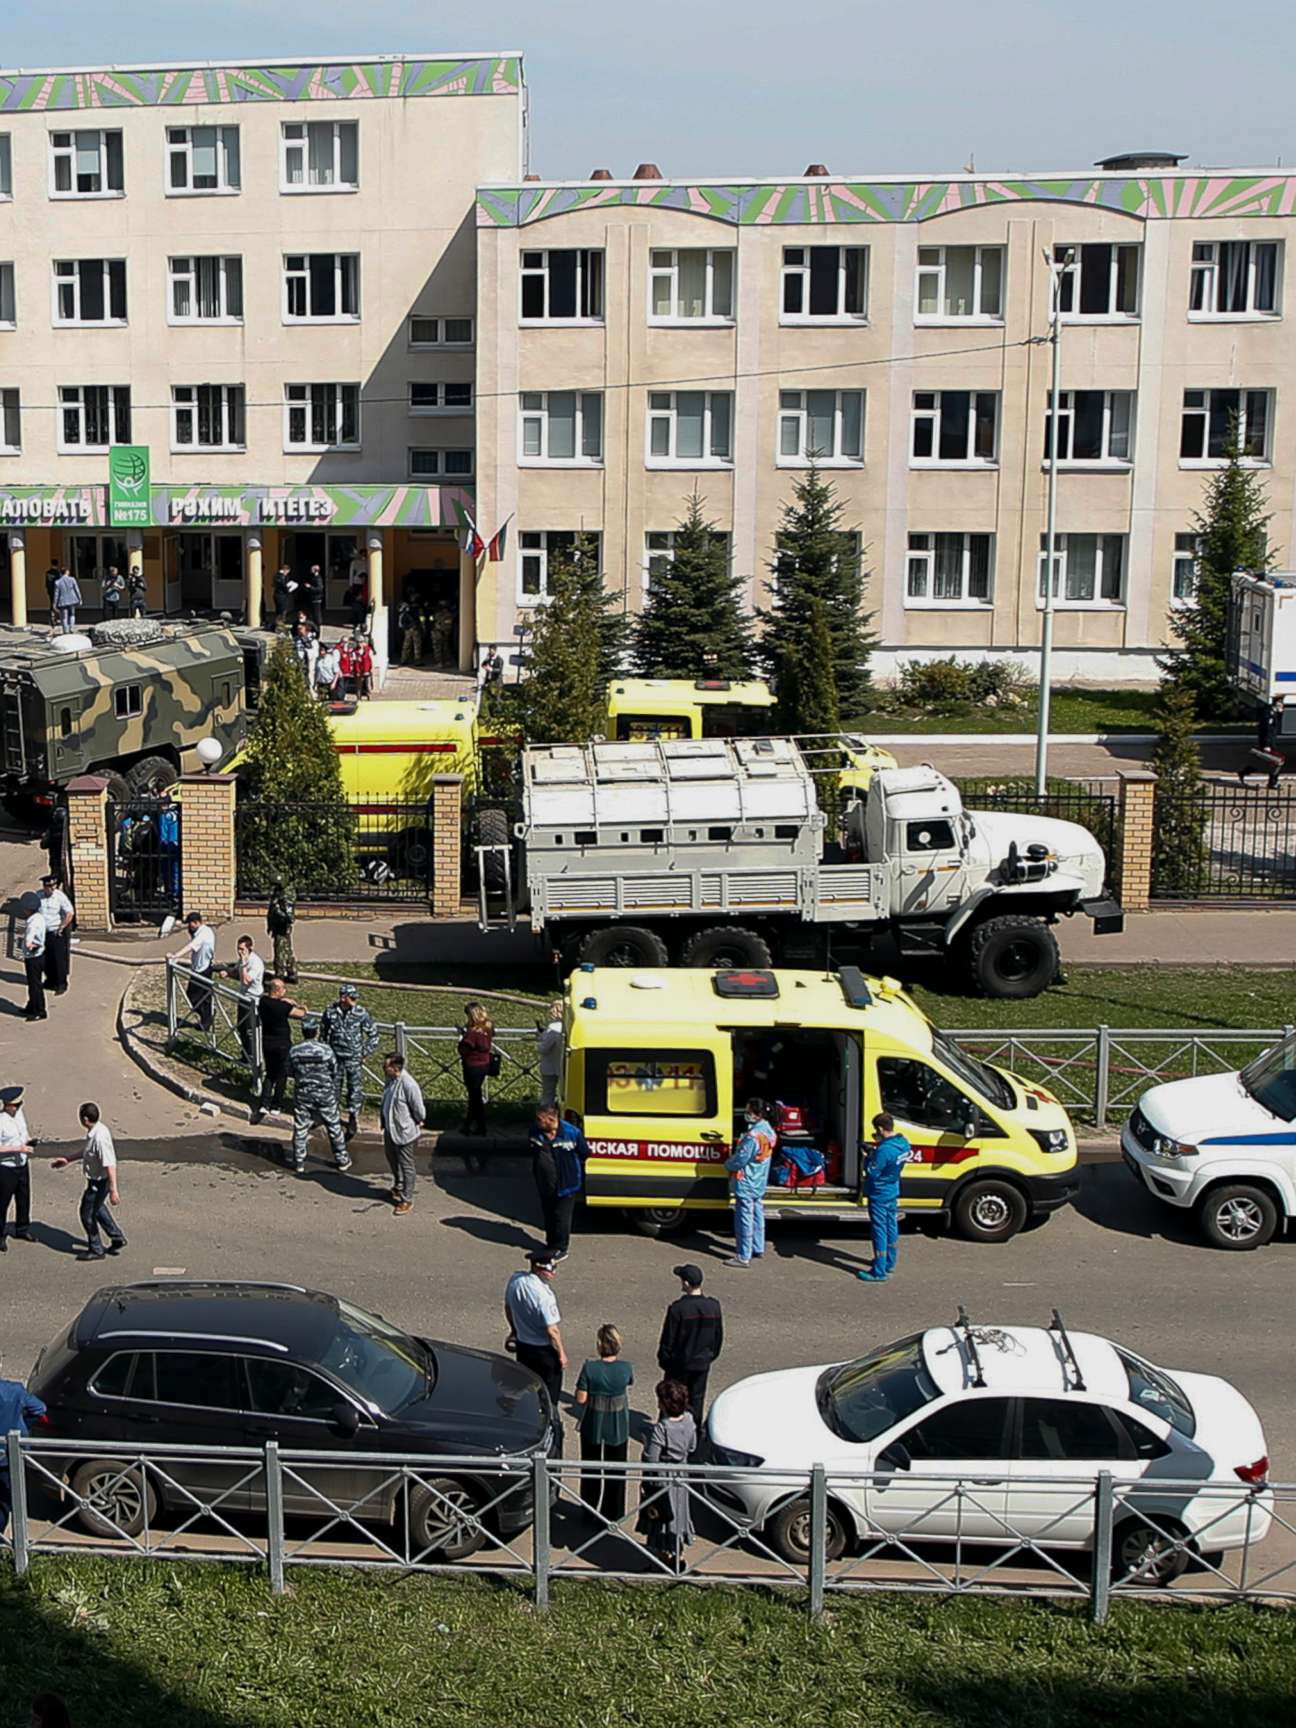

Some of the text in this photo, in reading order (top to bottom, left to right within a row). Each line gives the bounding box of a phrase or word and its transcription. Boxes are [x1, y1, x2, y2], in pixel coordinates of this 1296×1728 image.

[113, 509, 147, 521] №175
[260, 496, 334, 520] ИТЕГЕЗ
[647, 1143, 721, 1160] ПОМОЩЬ
